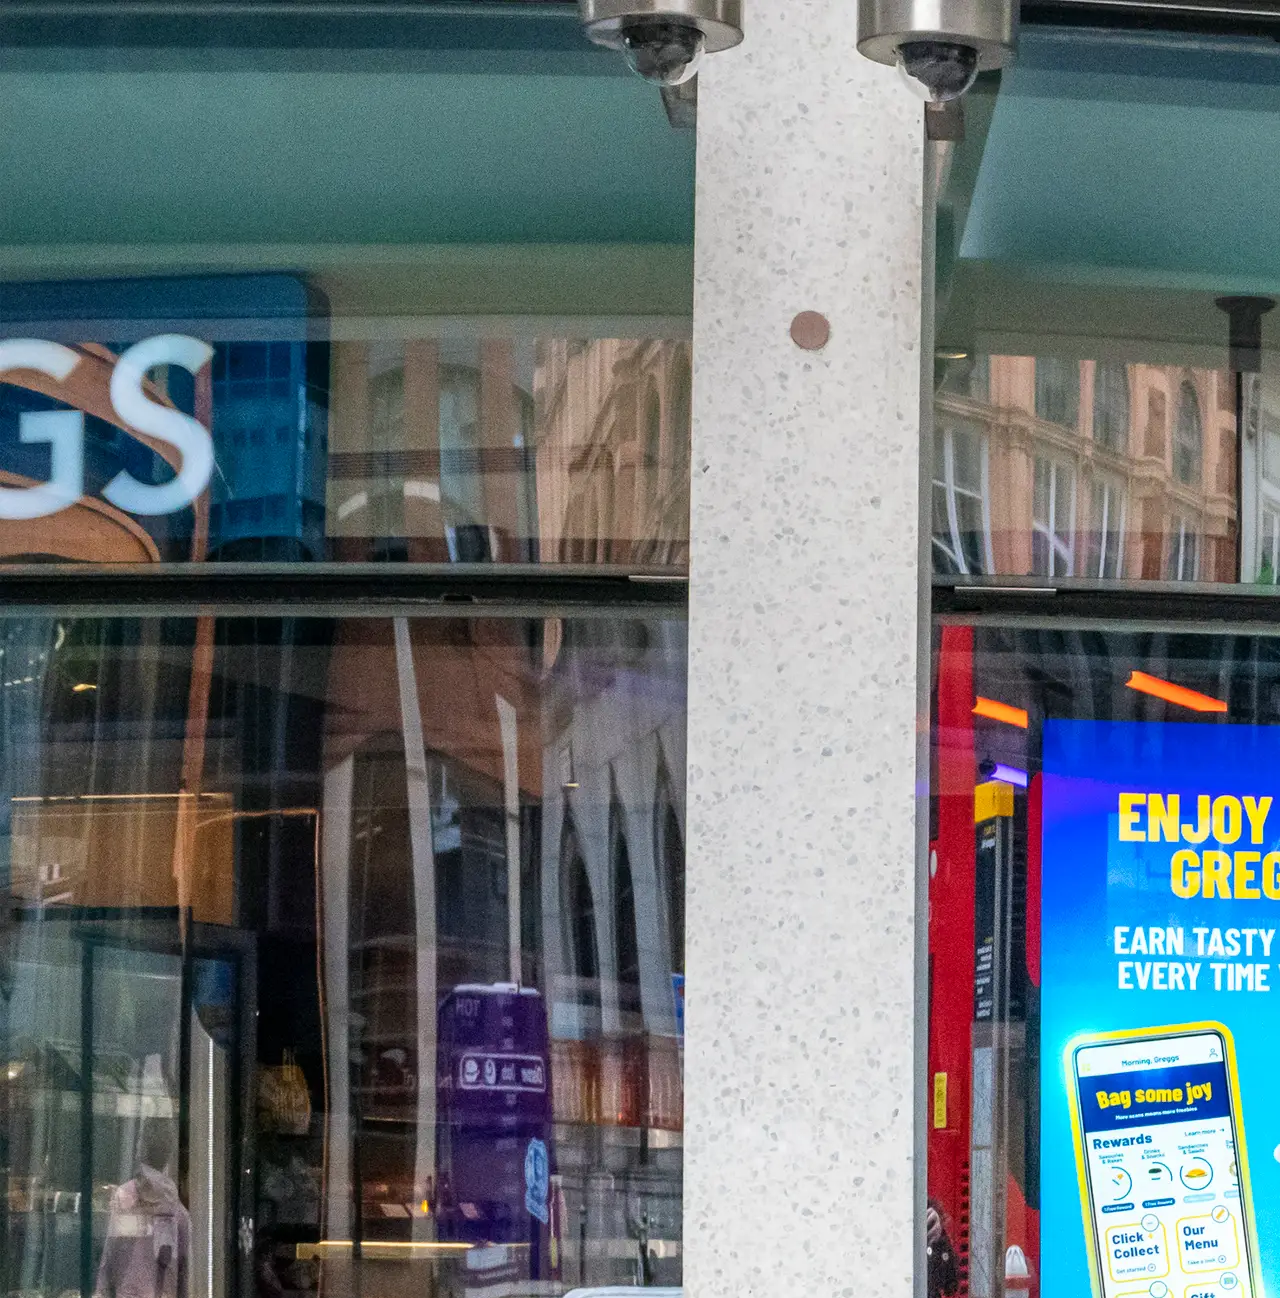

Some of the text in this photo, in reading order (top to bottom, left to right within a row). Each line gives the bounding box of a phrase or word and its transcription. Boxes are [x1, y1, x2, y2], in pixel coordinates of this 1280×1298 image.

[1117, 792, 1272, 844] ENJOY
[1113, 926, 1184, 956] EARN
[1195, 927, 1276, 957] TASTY
[1117, 961, 1200, 990] EVERY
[1209, 962, 1270, 992] TIME
[1121, 1055, 1180, 1067] Morning, Greggs
[1096, 1082, 1212, 1109] Bag some joy
[1092, 1134, 1152, 1150] Rewards
[1183, 1225, 1205, 1236] Our
[1112, 1232, 1144, 1245] Click
[1184, 1239, 1218, 1250] Menu
[1114, 1244, 1159, 1259] Collect
